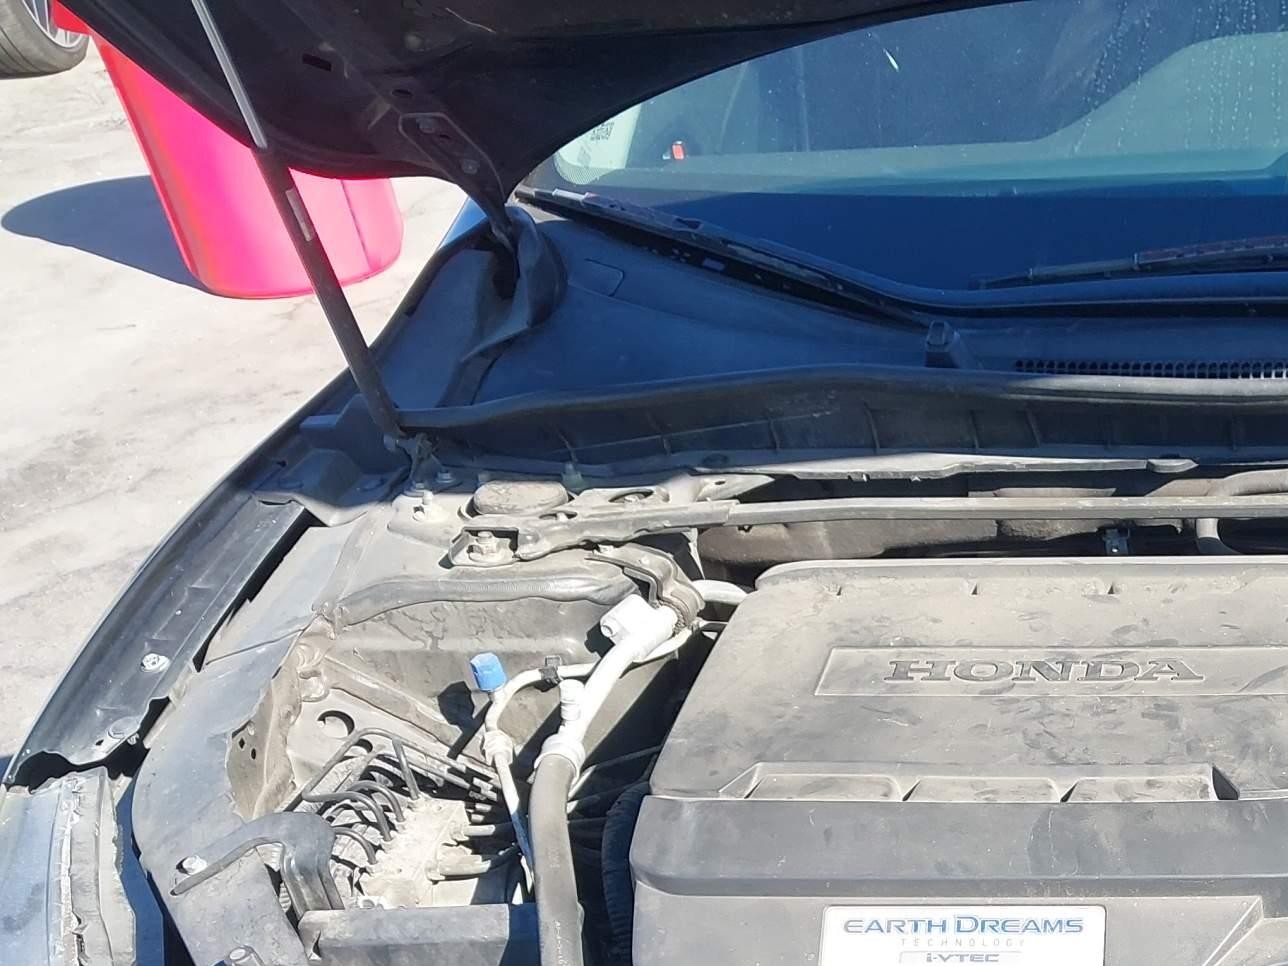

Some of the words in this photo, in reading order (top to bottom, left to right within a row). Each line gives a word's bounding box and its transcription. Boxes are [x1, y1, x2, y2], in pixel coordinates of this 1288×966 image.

[883, 659, 1205, 682] HONDA
[843, 919, 947, 934] EARTH
[956, 915, 1084, 934] DREAMS
[900, 938, 1025, 947] TECHNOLOGY
[926, 952, 1000, 963] i-VTEC
